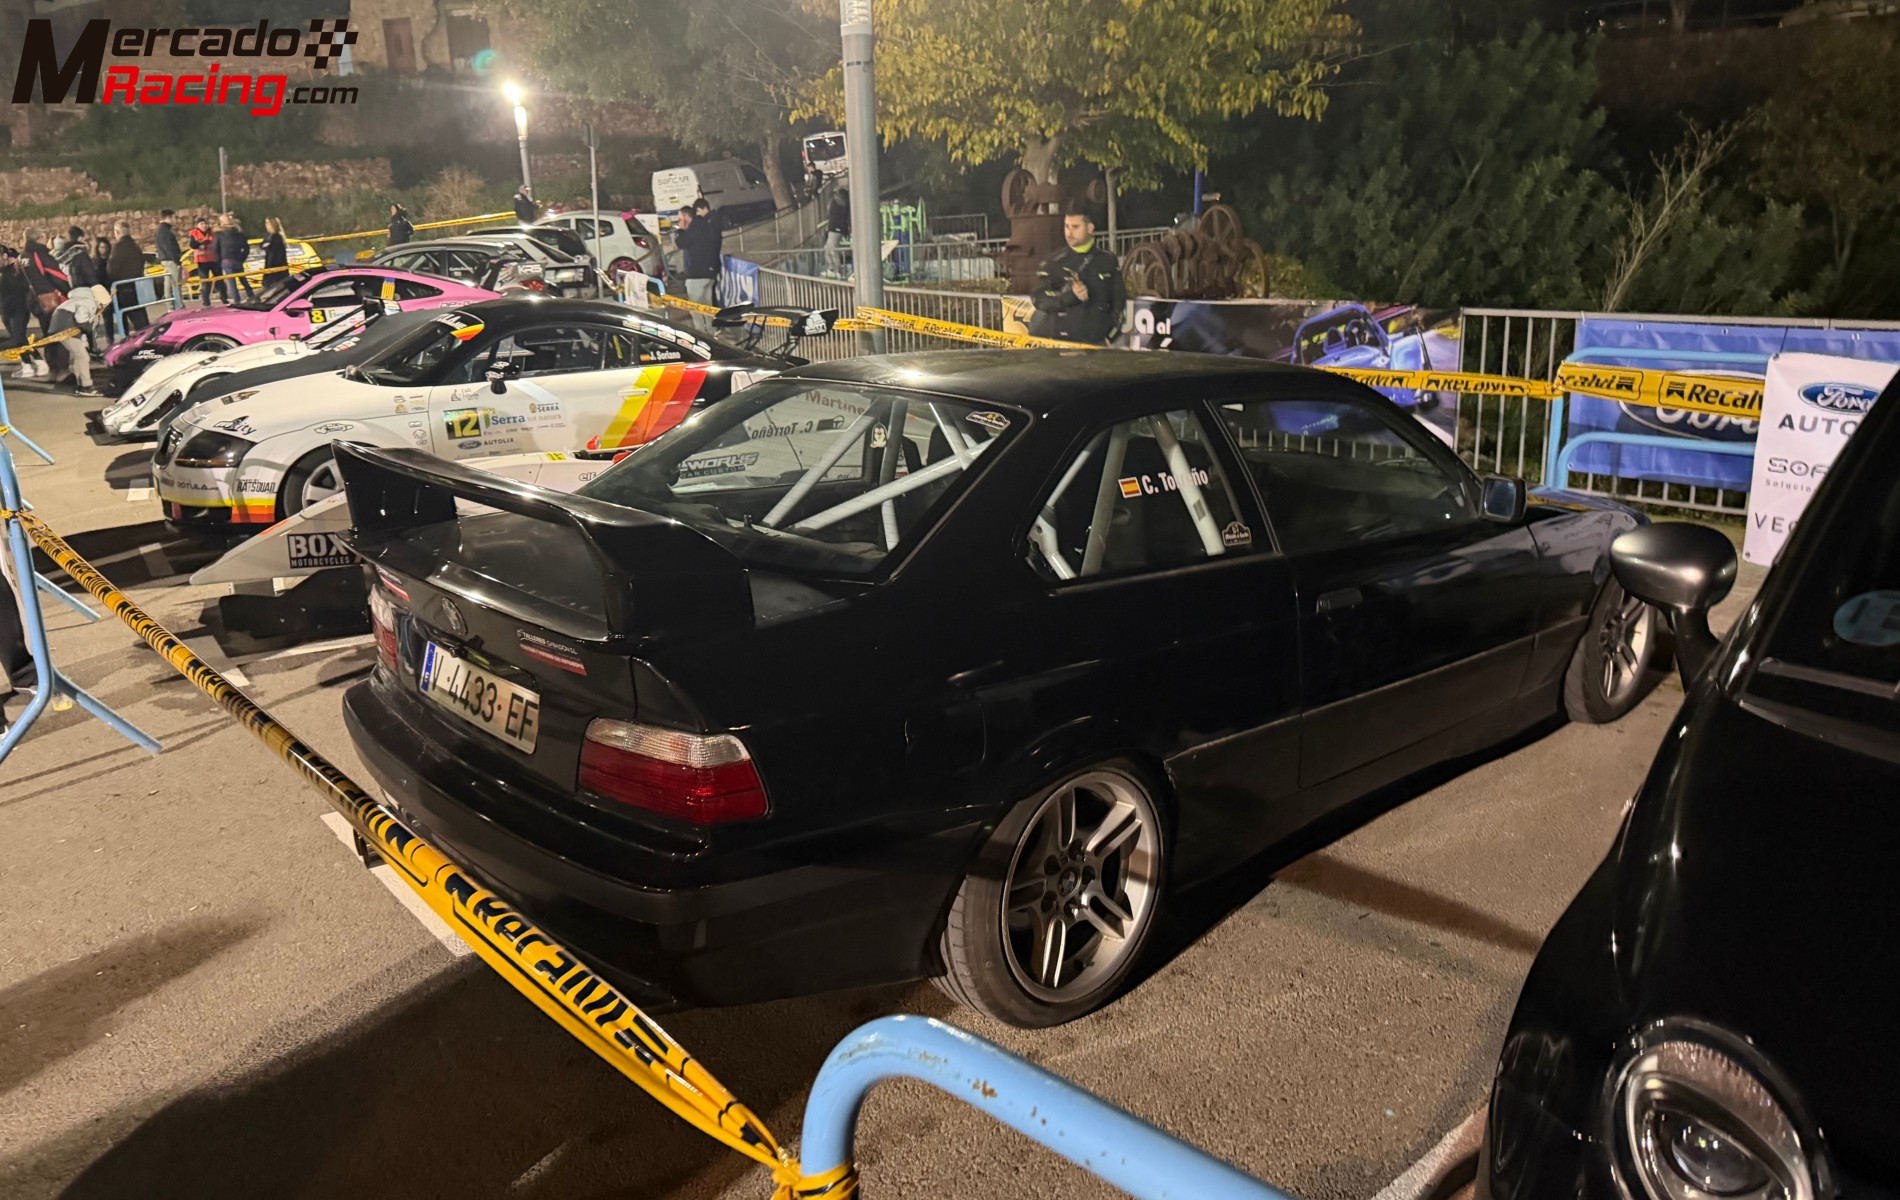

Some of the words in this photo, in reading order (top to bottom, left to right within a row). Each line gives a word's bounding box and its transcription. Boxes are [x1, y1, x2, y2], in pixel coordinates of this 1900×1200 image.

[311, 310, 325, 323] 8
[452, 409, 480, 438] 12
[491, 415, 526, 426] Serra
[288, 533, 349, 558] BOX
[291, 556, 350, 568] MOTORCYCLES
